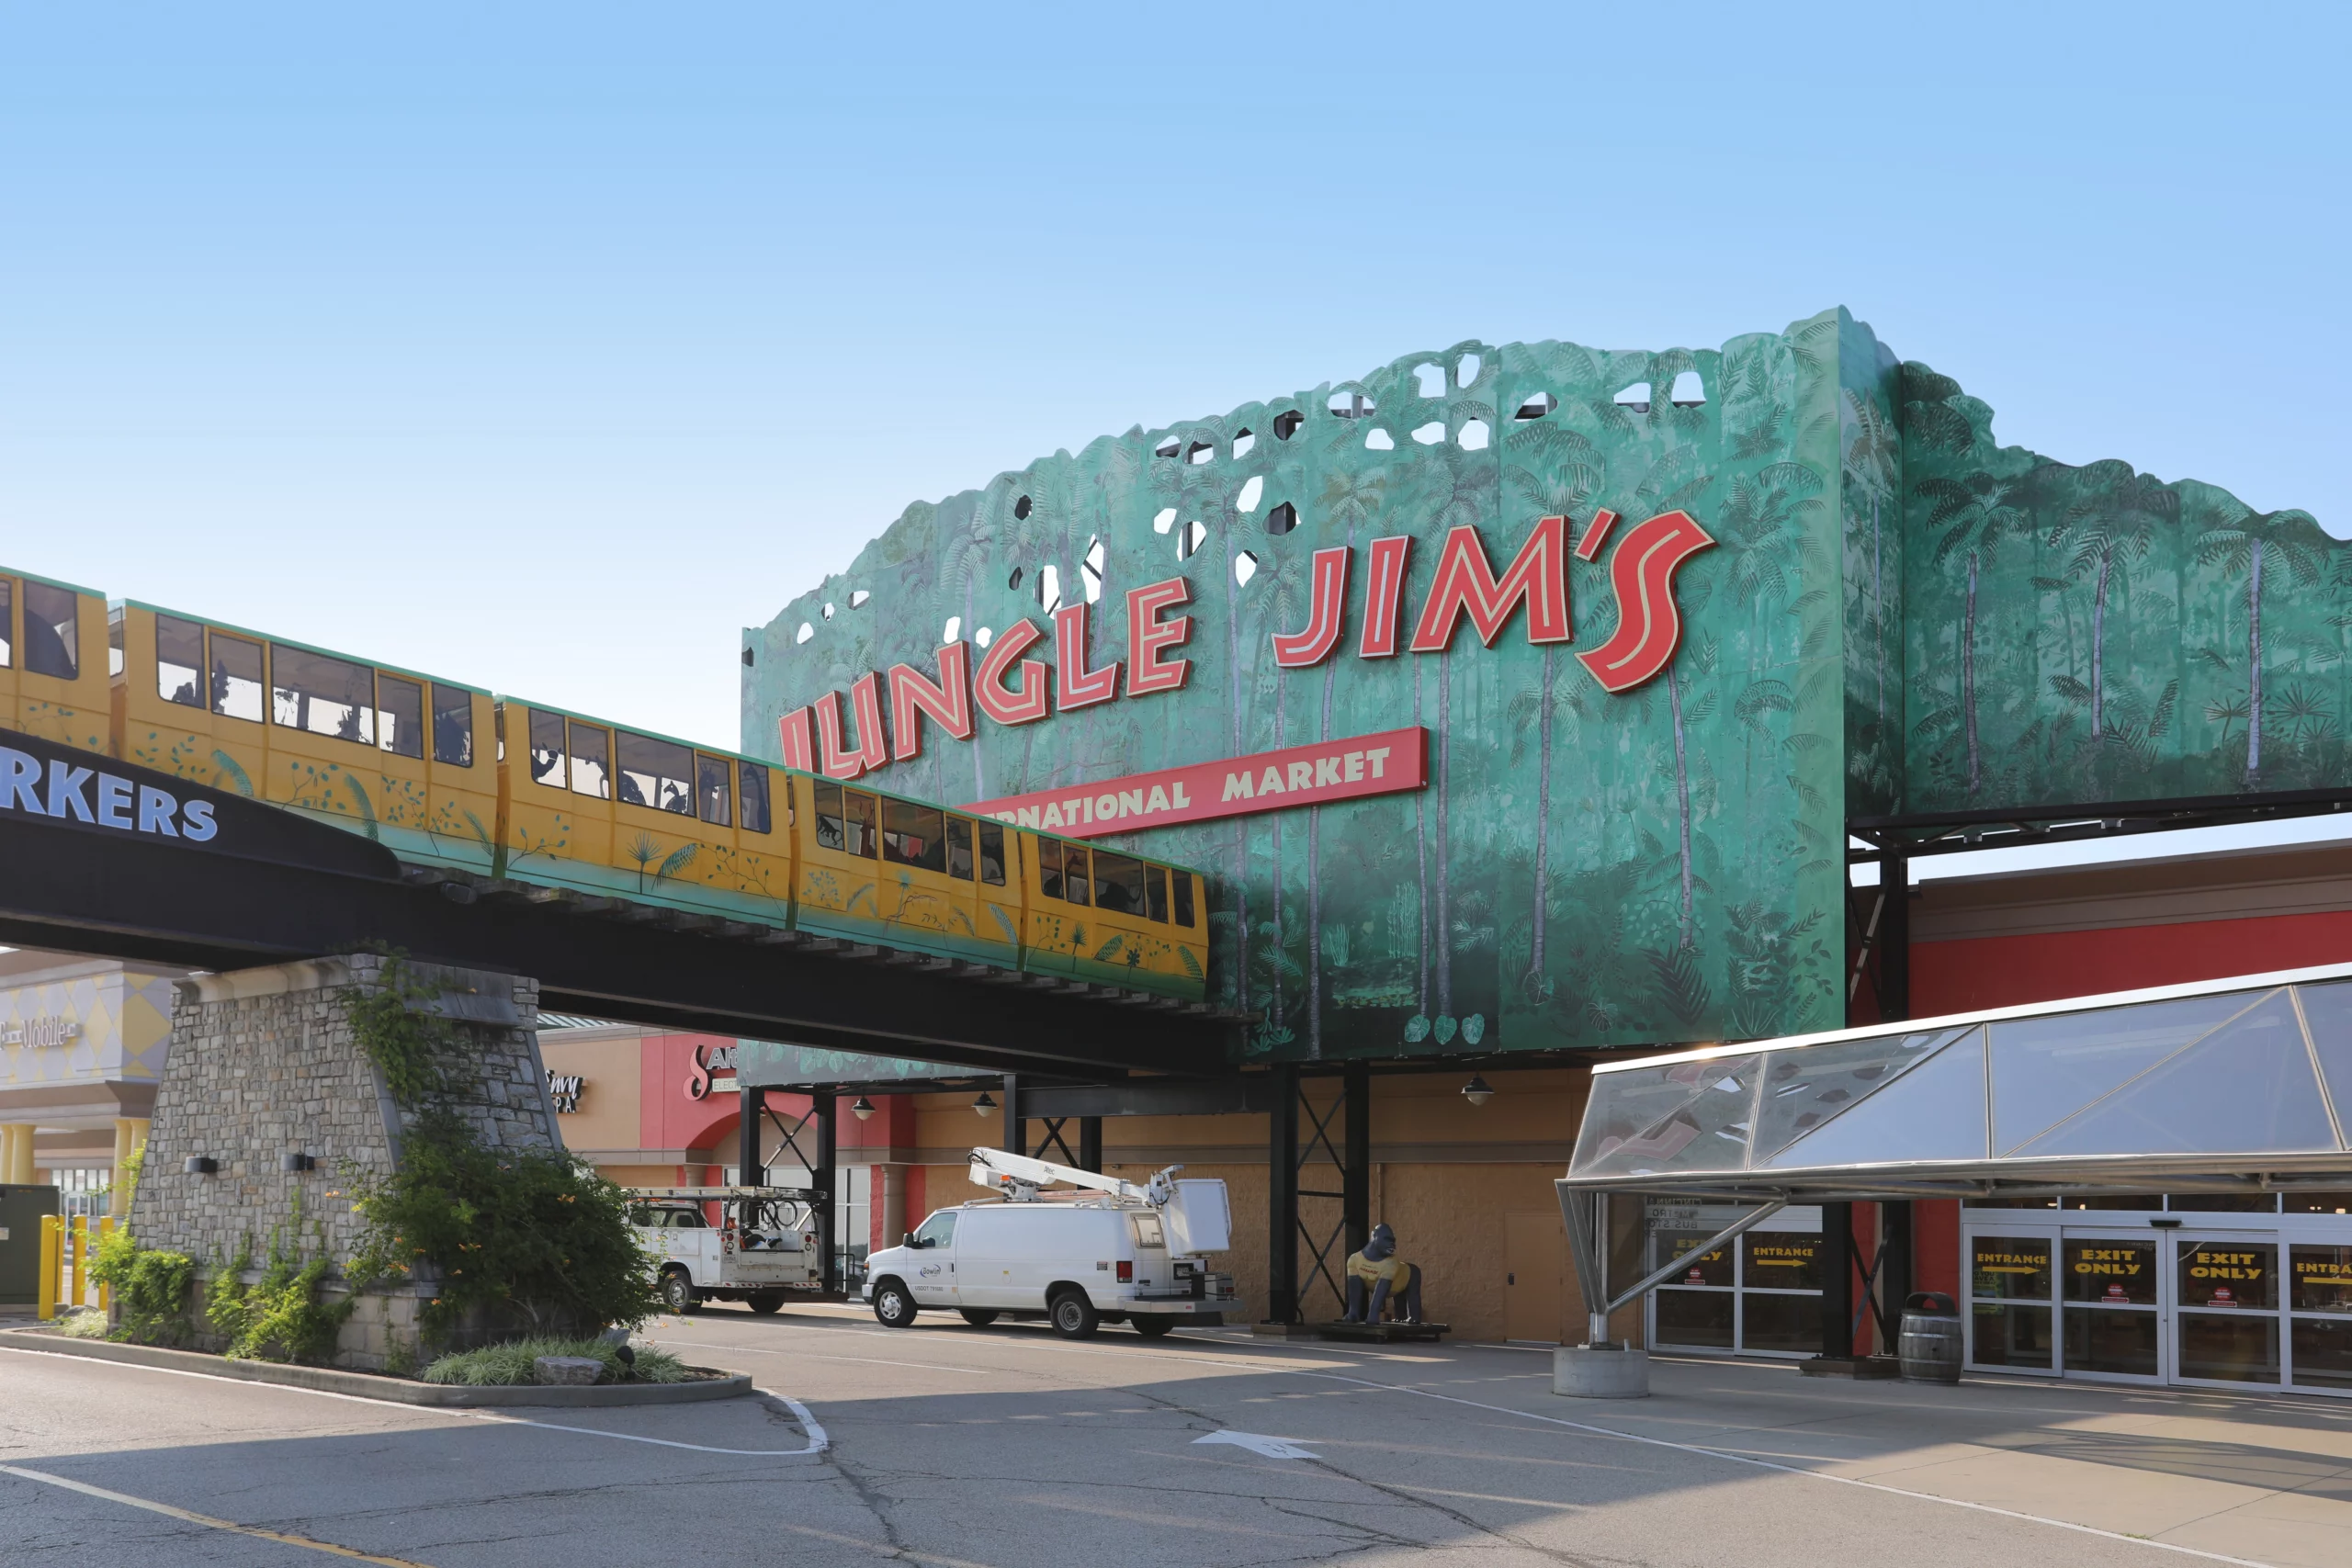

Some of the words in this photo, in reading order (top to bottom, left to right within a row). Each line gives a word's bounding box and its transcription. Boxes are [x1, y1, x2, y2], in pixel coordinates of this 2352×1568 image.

[1271, 507, 1717, 694] JIM'S
[1221, 747, 1391, 802] MARKET
[1753, 1247, 1814, 1258] ENTRANCE
[1977, 1253, 2047, 1265] ENTRANCE
[2081, 1248, 2136, 1261] EXIT
[2197, 1252, 2256, 1265] EXIT
[2074, 1262, 2142, 1275] ONLY
[2190, 1267, 2263, 1280] ONLY
